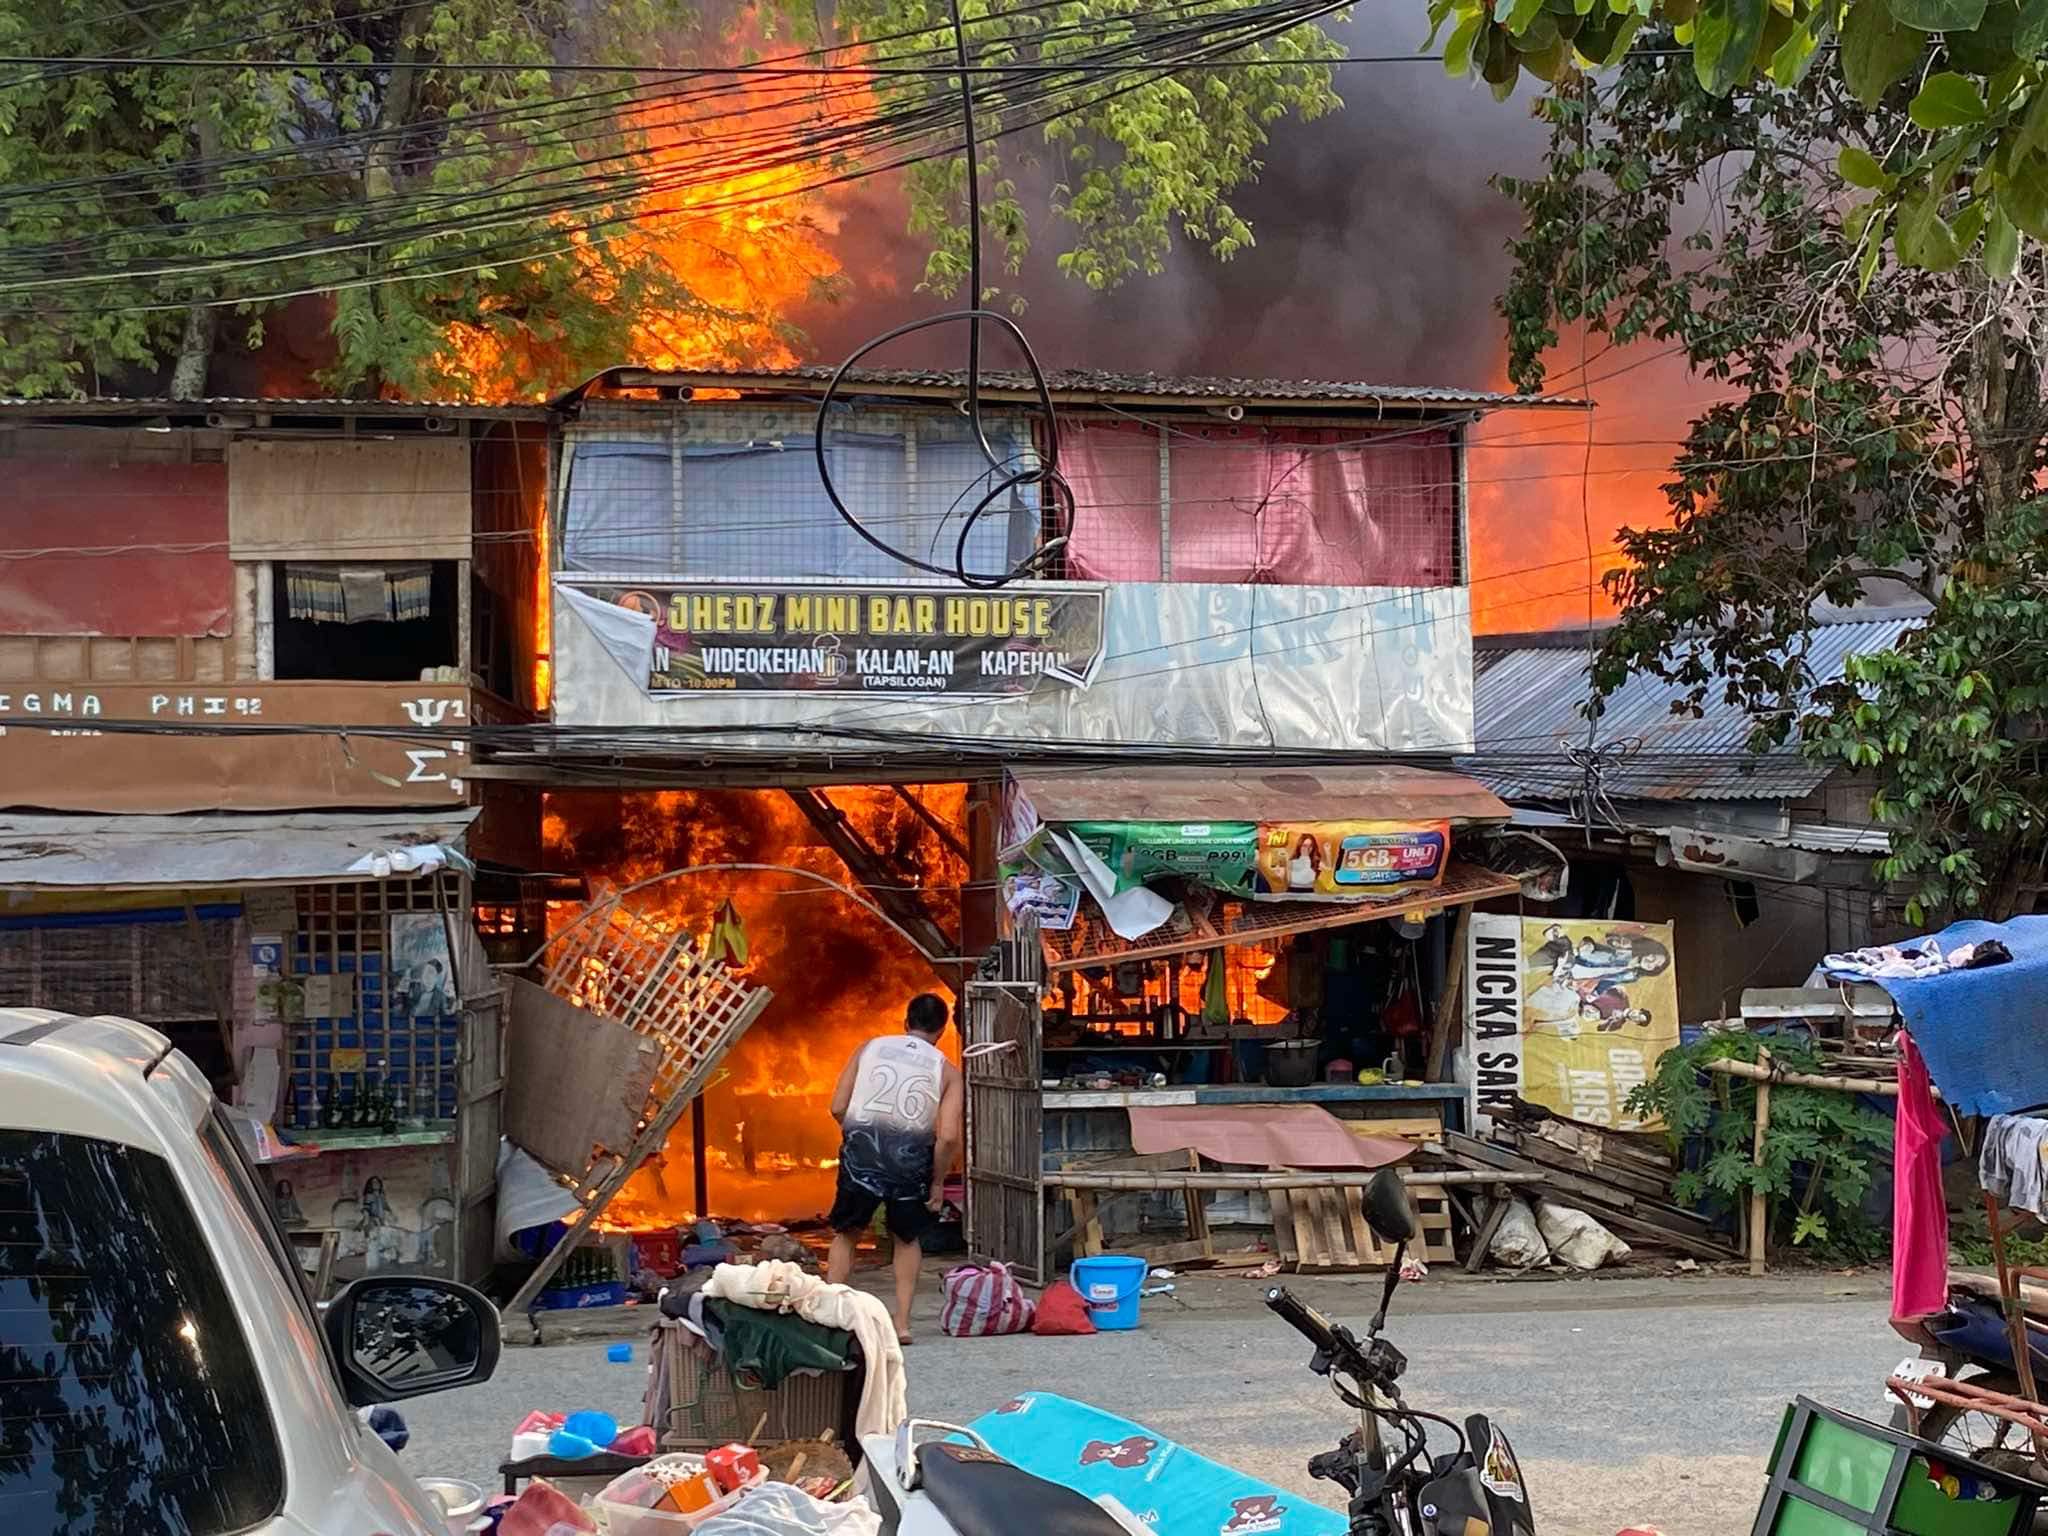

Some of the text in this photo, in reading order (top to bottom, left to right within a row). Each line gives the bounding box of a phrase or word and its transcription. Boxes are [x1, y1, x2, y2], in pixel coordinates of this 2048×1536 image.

[668, 593, 1051, 637] JHEDZ MINI BAR HOUSE
[701, 647, 825, 673] VIDEOKEHAN
[856, 649, 954, 675] KALAN-AN
[863, 676, 946, 688] (TAPSILOGAN)
[1475, 937, 1517, 1040] NICKA
[863, 1064, 933, 1120] 26
